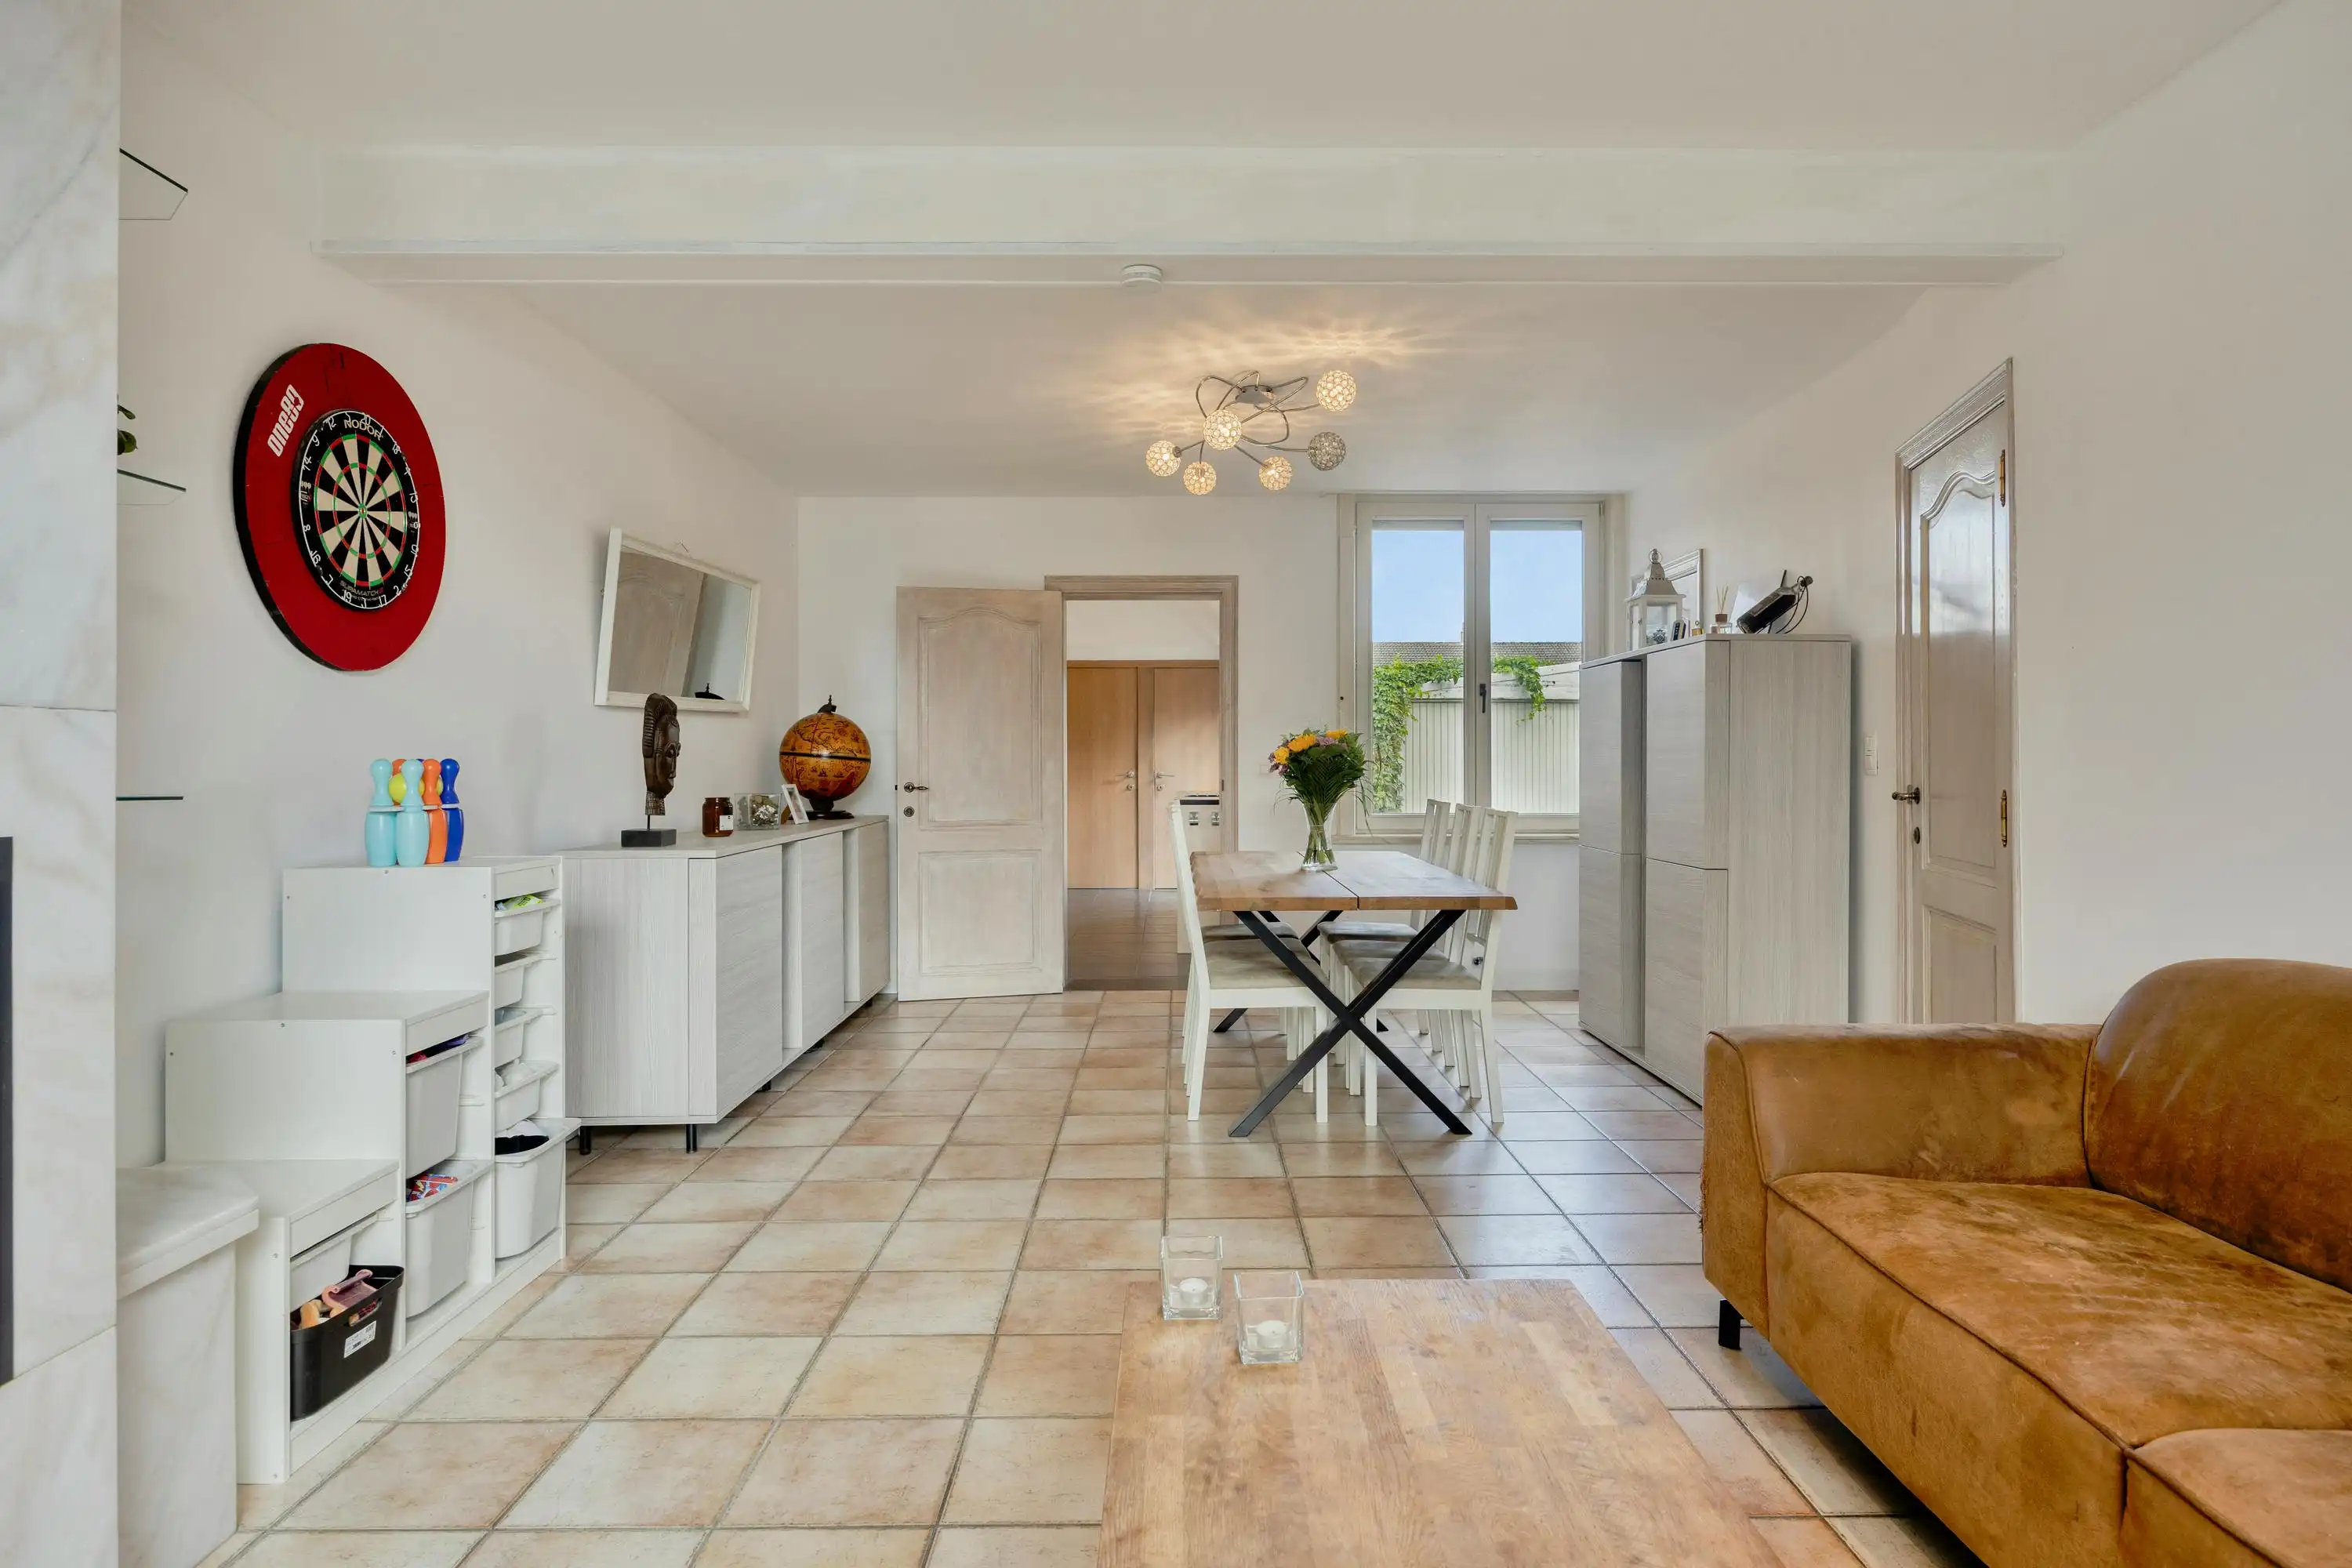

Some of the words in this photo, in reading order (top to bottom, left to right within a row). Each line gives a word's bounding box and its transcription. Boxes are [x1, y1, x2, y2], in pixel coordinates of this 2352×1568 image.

[325, 416, 337, 430] 12
[361, 412, 372, 425] 20
[343, 419, 383, 441] NODOR
[313, 434, 320, 447] 9
[303, 524, 311, 532] 8
[410, 544, 419, 556] 10
[310, 550, 321, 564] 16
[403, 564, 412, 579] 15
[341, 590, 352, 603] 19
